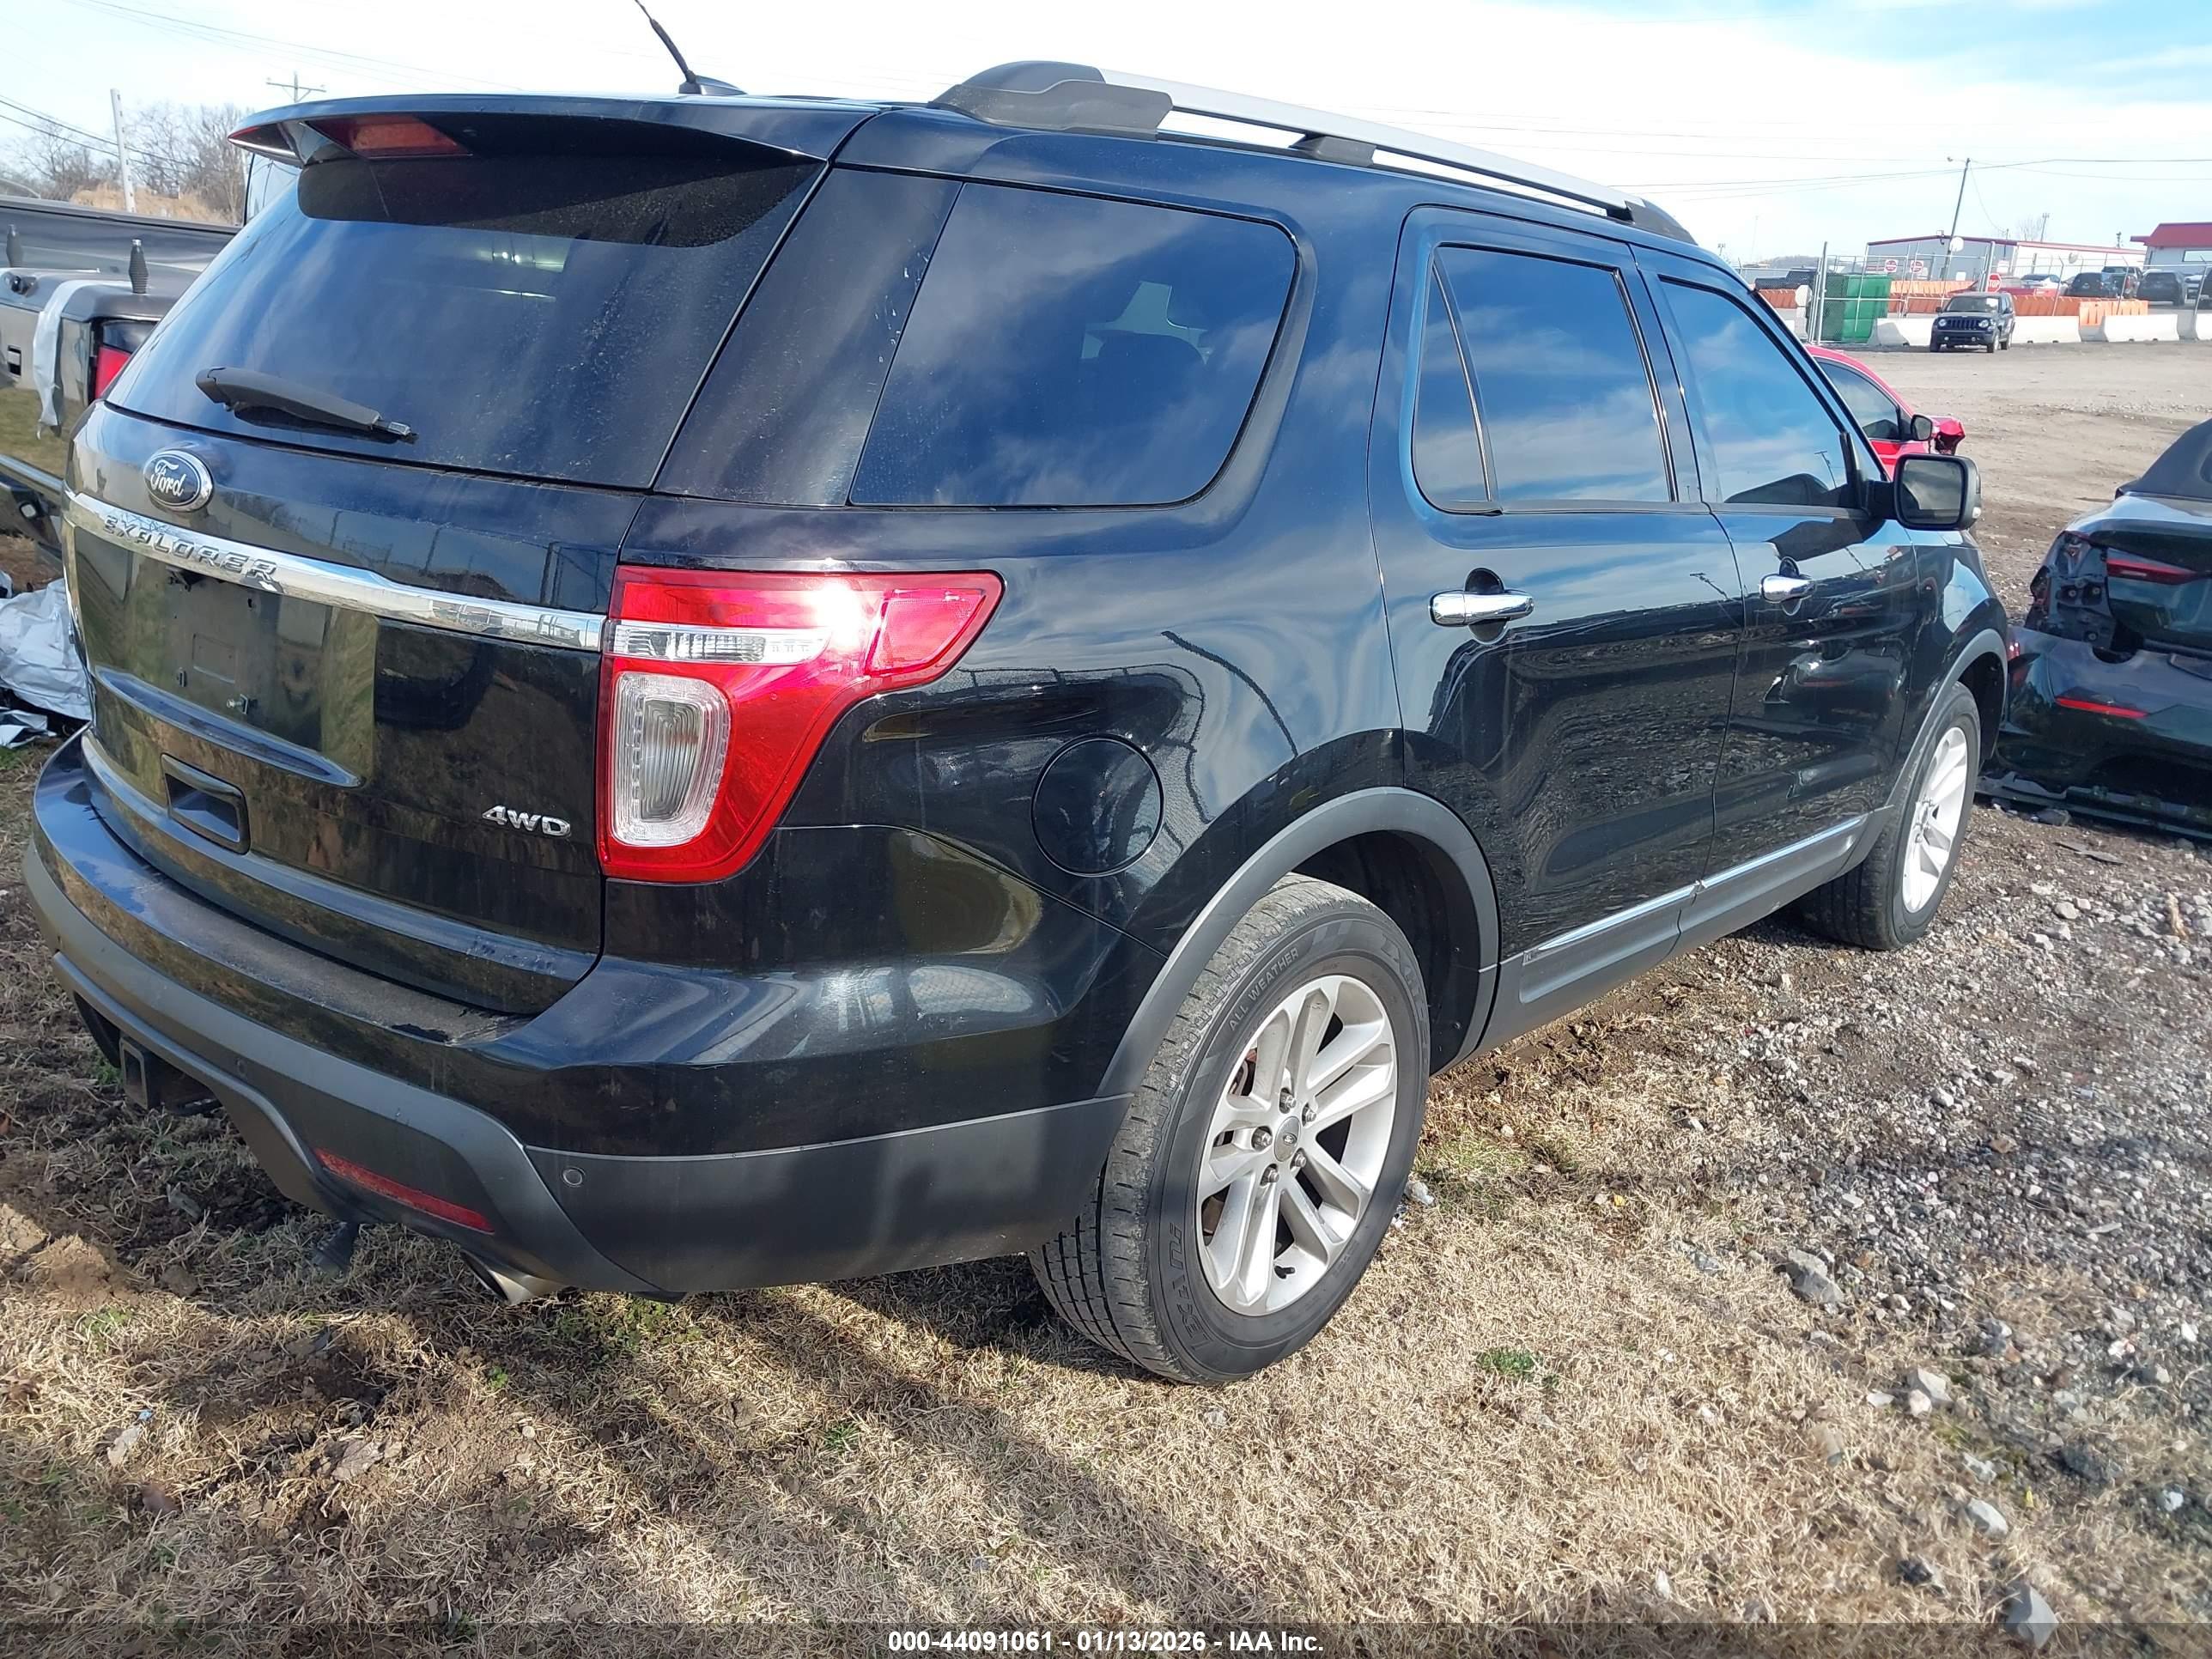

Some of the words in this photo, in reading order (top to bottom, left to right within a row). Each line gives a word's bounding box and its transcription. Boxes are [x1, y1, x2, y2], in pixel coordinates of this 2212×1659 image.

[150, 459, 186, 496] Ford
[103, 515, 279, 585] EXPLORER
[482, 805, 571, 836] 4WD
[1229, 1005, 1249, 1030] ALL
[1248, 947, 1299, 1001] WEATHER
